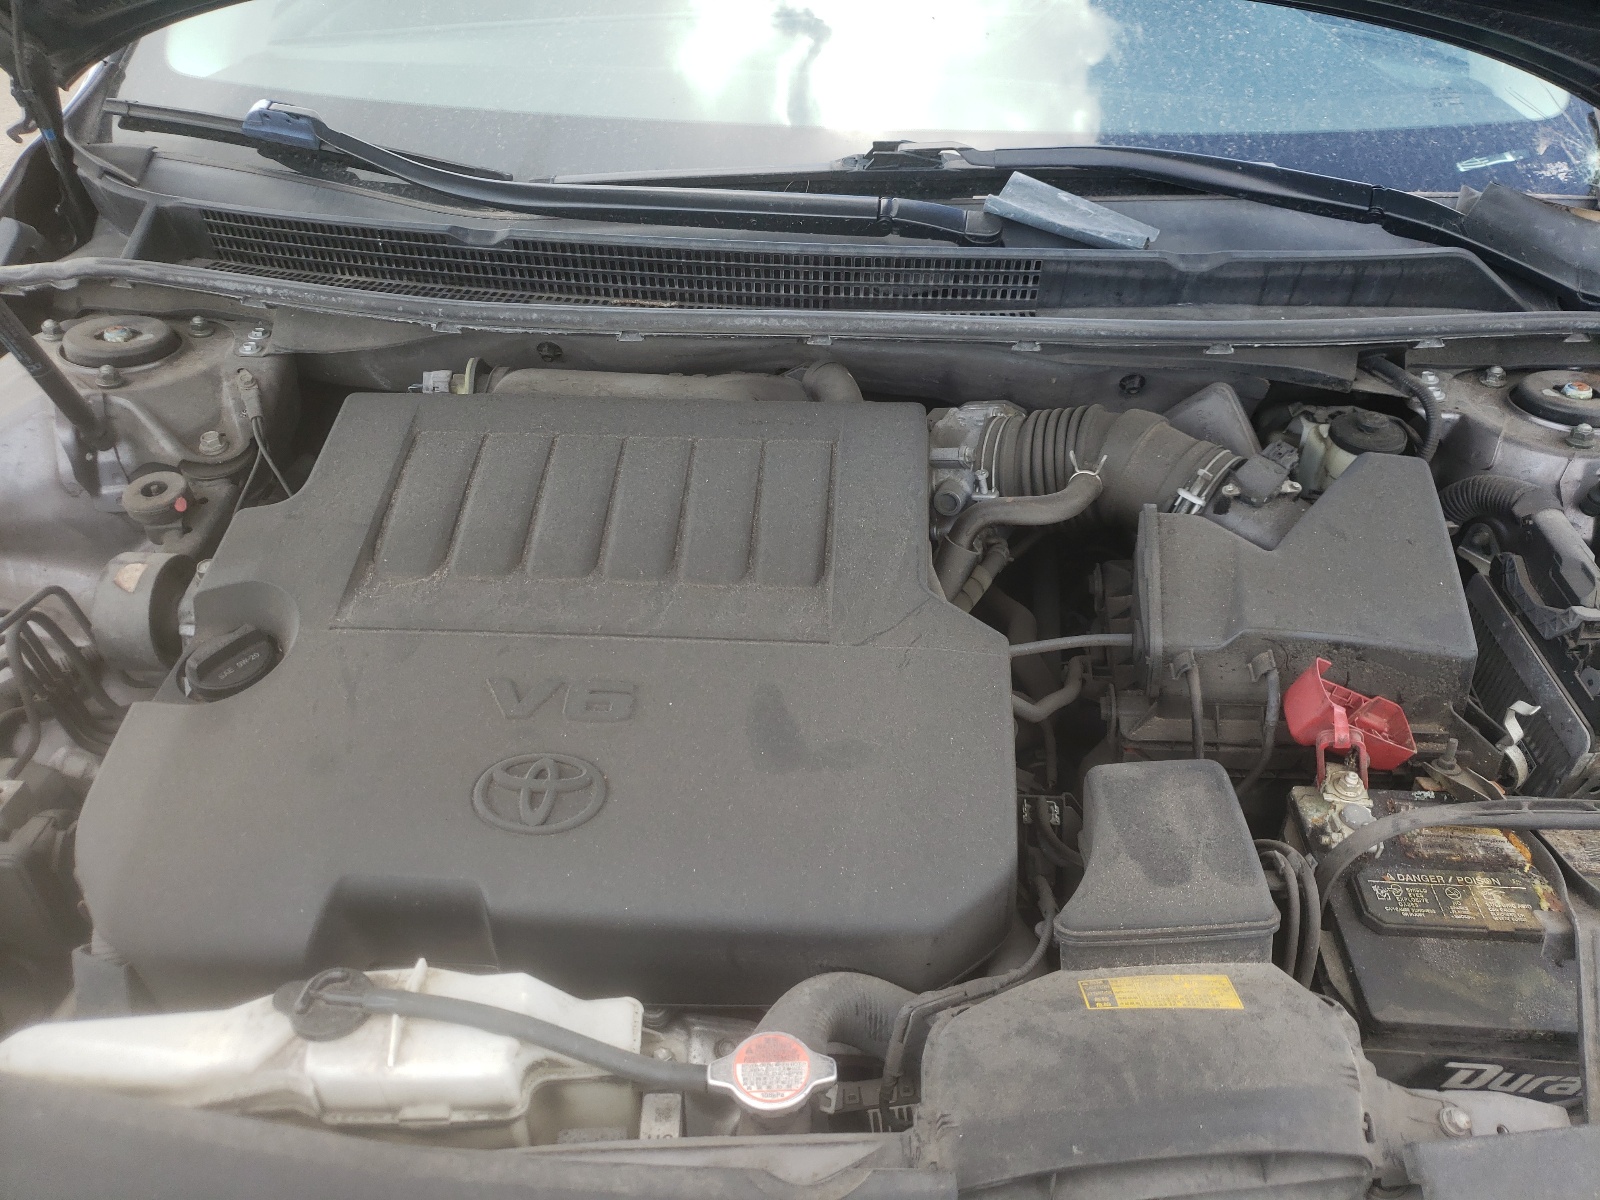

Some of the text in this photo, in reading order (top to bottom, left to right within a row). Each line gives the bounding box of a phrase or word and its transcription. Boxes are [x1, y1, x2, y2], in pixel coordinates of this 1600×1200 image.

[485, 676, 639, 723] V6
[1397, 873, 1445, 884] DANGER
[1456, 876, 1501, 886] POISON
[1441, 1062, 1582, 1096] Dura
